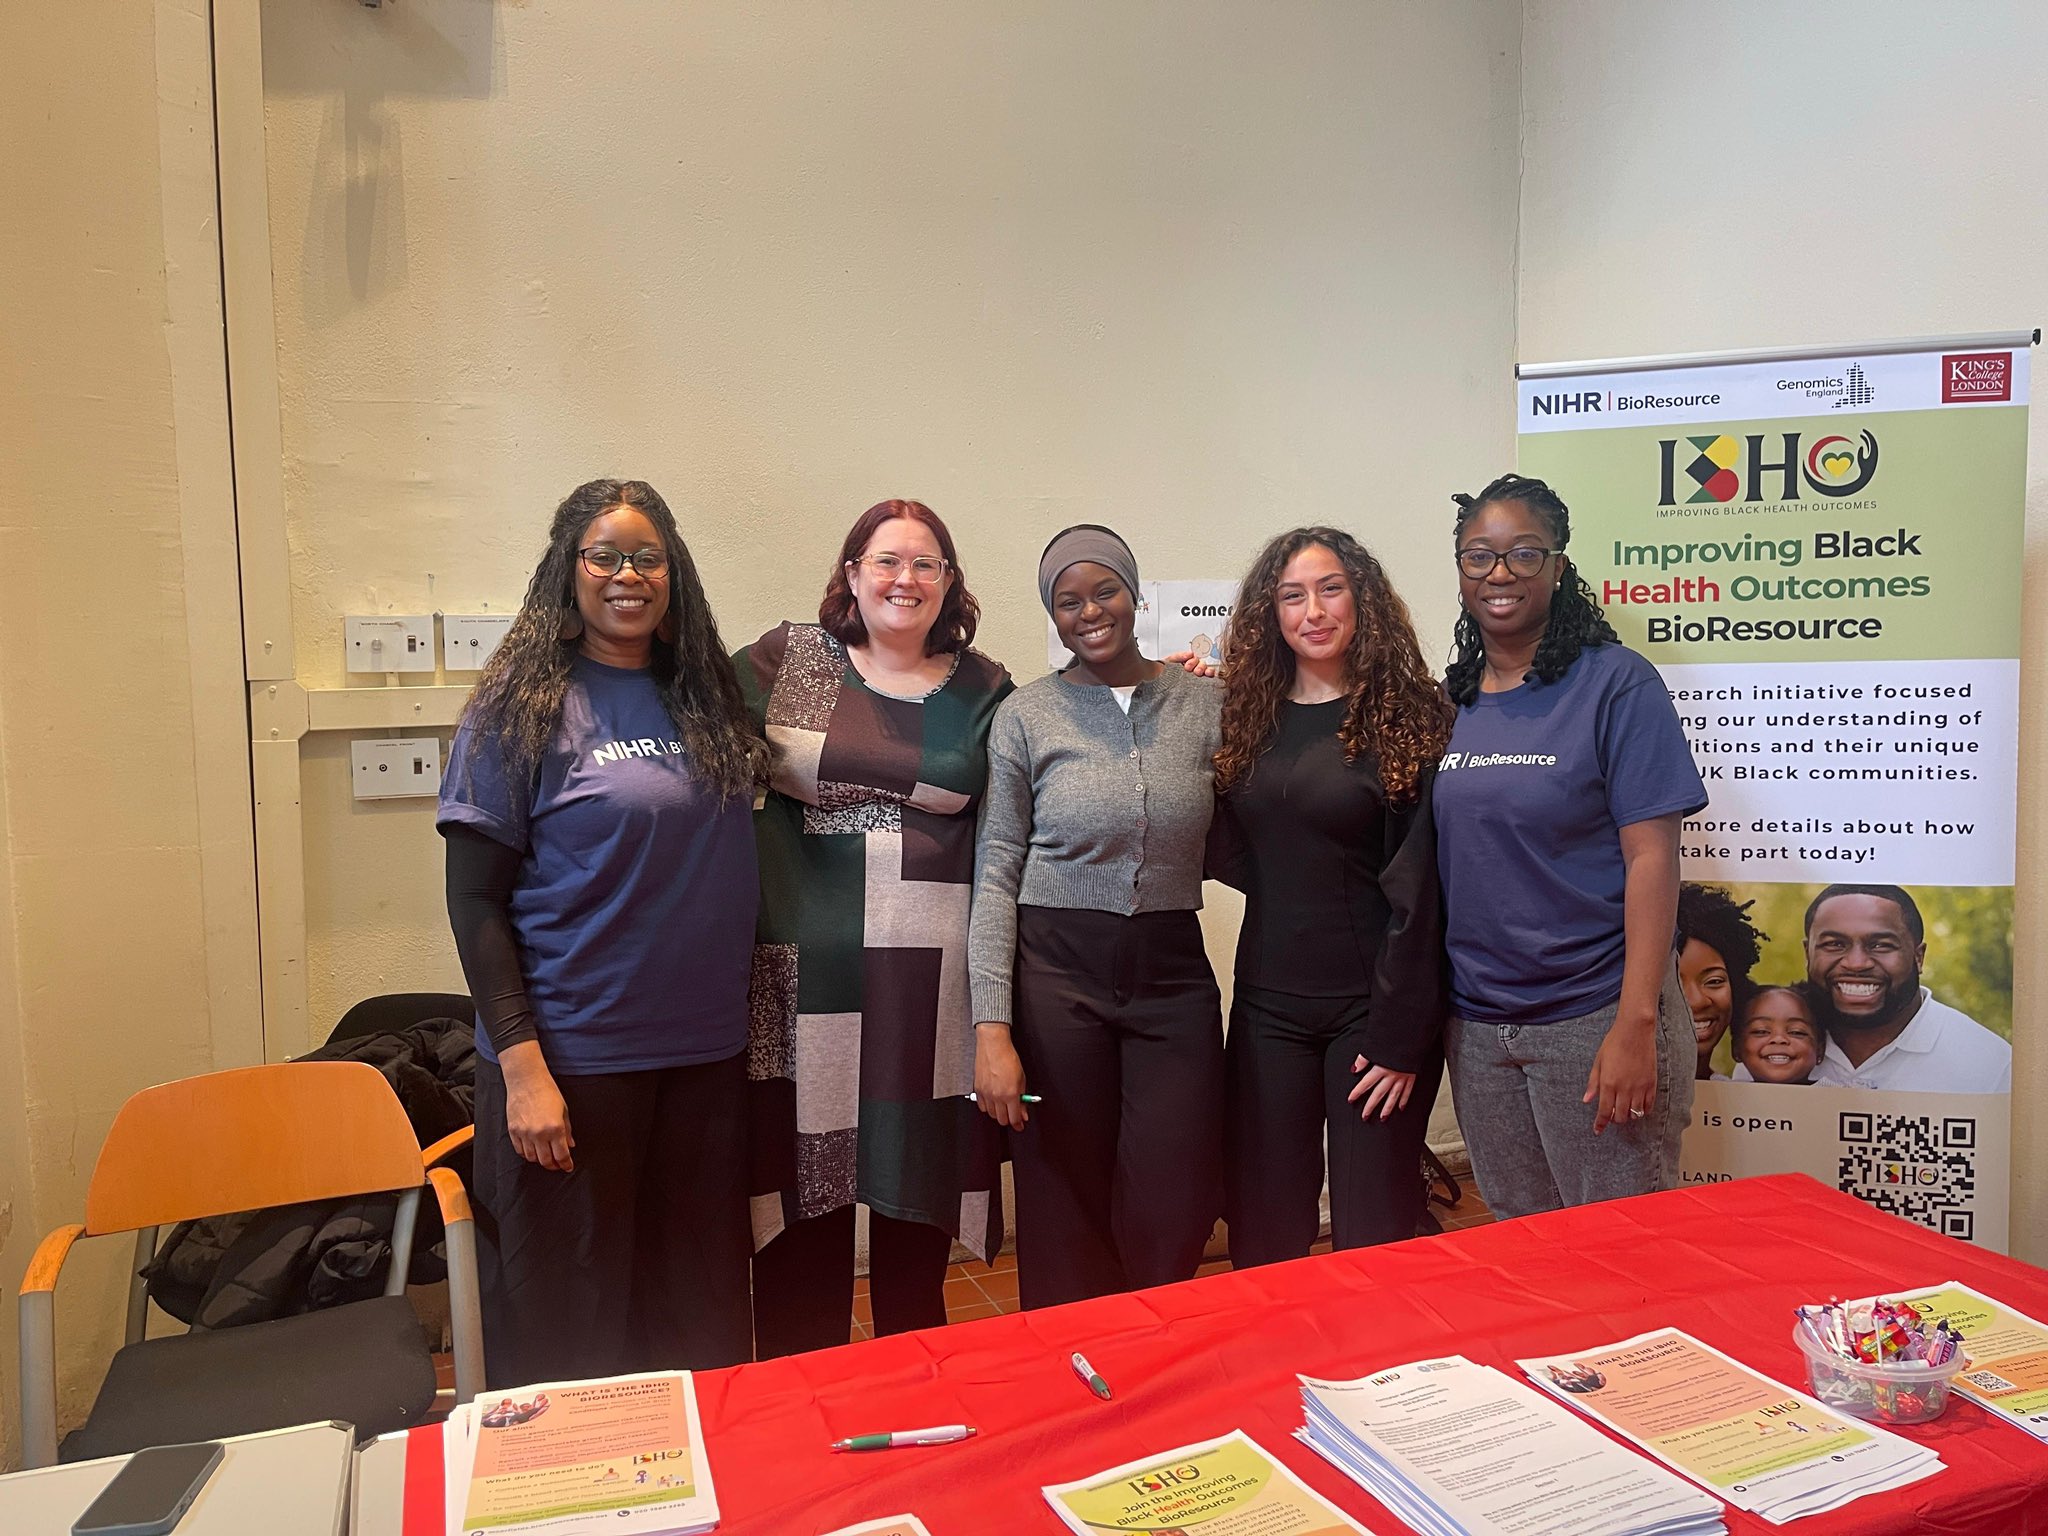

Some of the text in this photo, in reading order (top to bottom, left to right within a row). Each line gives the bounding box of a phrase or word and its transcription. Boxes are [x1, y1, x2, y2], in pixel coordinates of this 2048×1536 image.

[1950, 358, 2005, 381] KING'S
[1967, 369, 2004, 381] College
[1776, 376, 1844, 391] Genomics
[1951, 379, 2004, 391] LONDON
[1805, 387, 1844, 399] England
[1532, 391, 1721, 416] NIHR BioResource
[1657, 428, 1879, 506] IBHO
[1656, 500, 1877, 518] IMPROVING BLACK HEALTH OUTCOMES
[1613, 529, 1923, 571] Improving Black
[1603, 575, 1931, 605] Health Outcomes
[1180, 605, 1235, 617] corner
[1647, 615, 1882, 643] BioResource
[1753, 684, 1863, 700] initiative
[1874, 683, 1972, 699] focused
[1717, 716, 1755, 726] our
[1766, 710, 1948, 729] understanding
[1958, 710, 1982, 725] of
[592, 738, 662, 767] NIHR
[1687, 738, 1979, 756] itions and their unique
[1468, 753, 1557, 768] BioResource
[1734, 765, 1799, 780] Black
[1808, 765, 1978, 780] communities.
[1683, 819, 1975, 835] more details about how
[1680, 844, 1875, 864] take part today!
[1703, 1111, 1793, 1132] is open
[1677, 1171, 1733, 1183] LAND
[1594, 1355, 1623, 1367] WHAT
[1624, 1352, 1635, 1361] IS
[1635, 1347, 1653, 1357] THE
[1618, 1345, 1688, 1369] BIORESOURCE?
[560, 1390, 597, 1398] WHAT
[641, 1381, 671, 1389] IBHO
[580, 1387, 671, 1402] BIORESOURCE?
[485, 1477, 511, 1485] What
[549, 1468, 573, 1476] need
[1116, 1476, 1260, 1527] Black Health Outcomes
[1123, 1473, 1237, 1514] Join the Improving
[1158, 1494, 1236, 1525] BioResource
